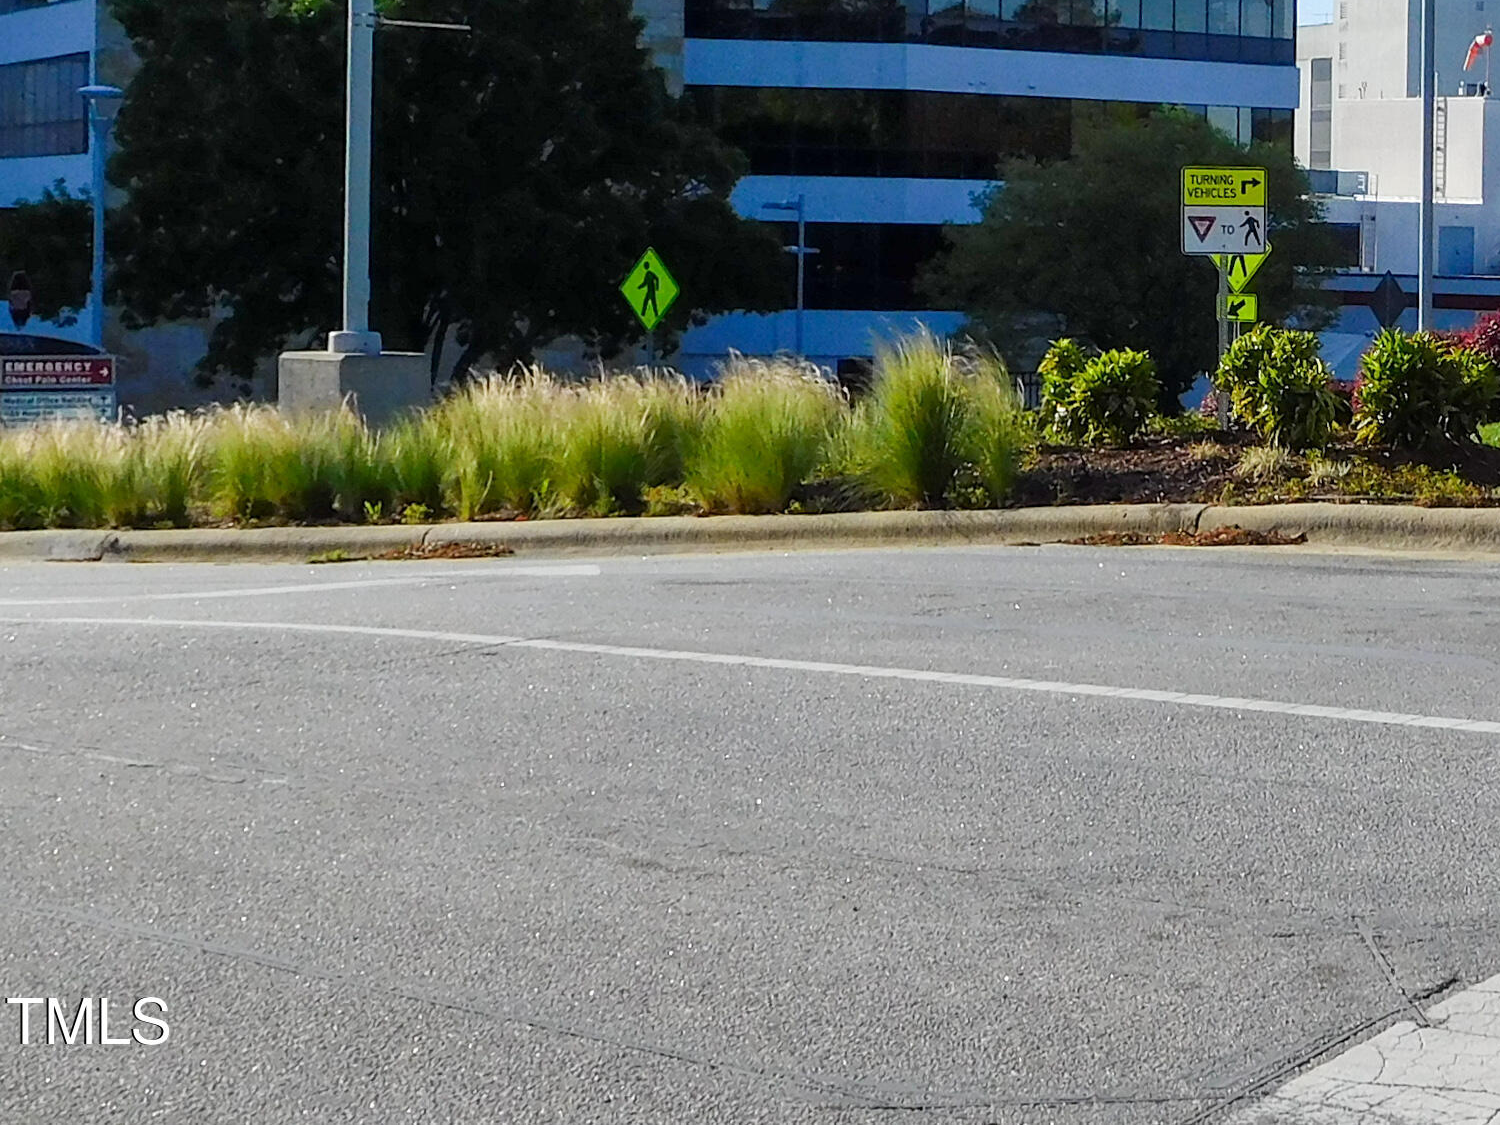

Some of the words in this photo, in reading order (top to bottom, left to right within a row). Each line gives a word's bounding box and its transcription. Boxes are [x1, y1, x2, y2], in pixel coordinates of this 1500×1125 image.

[1190, 175, 1234, 185] TURNING
[1187, 188, 1237, 198] VEHICLES
[1221, 225, 1235, 235] TO
[5, 362, 91, 372] EMERGENCY
[5, 376, 32, 384] Chest
[35, 376, 57, 384] Pain
[60, 376, 92, 384] Center
